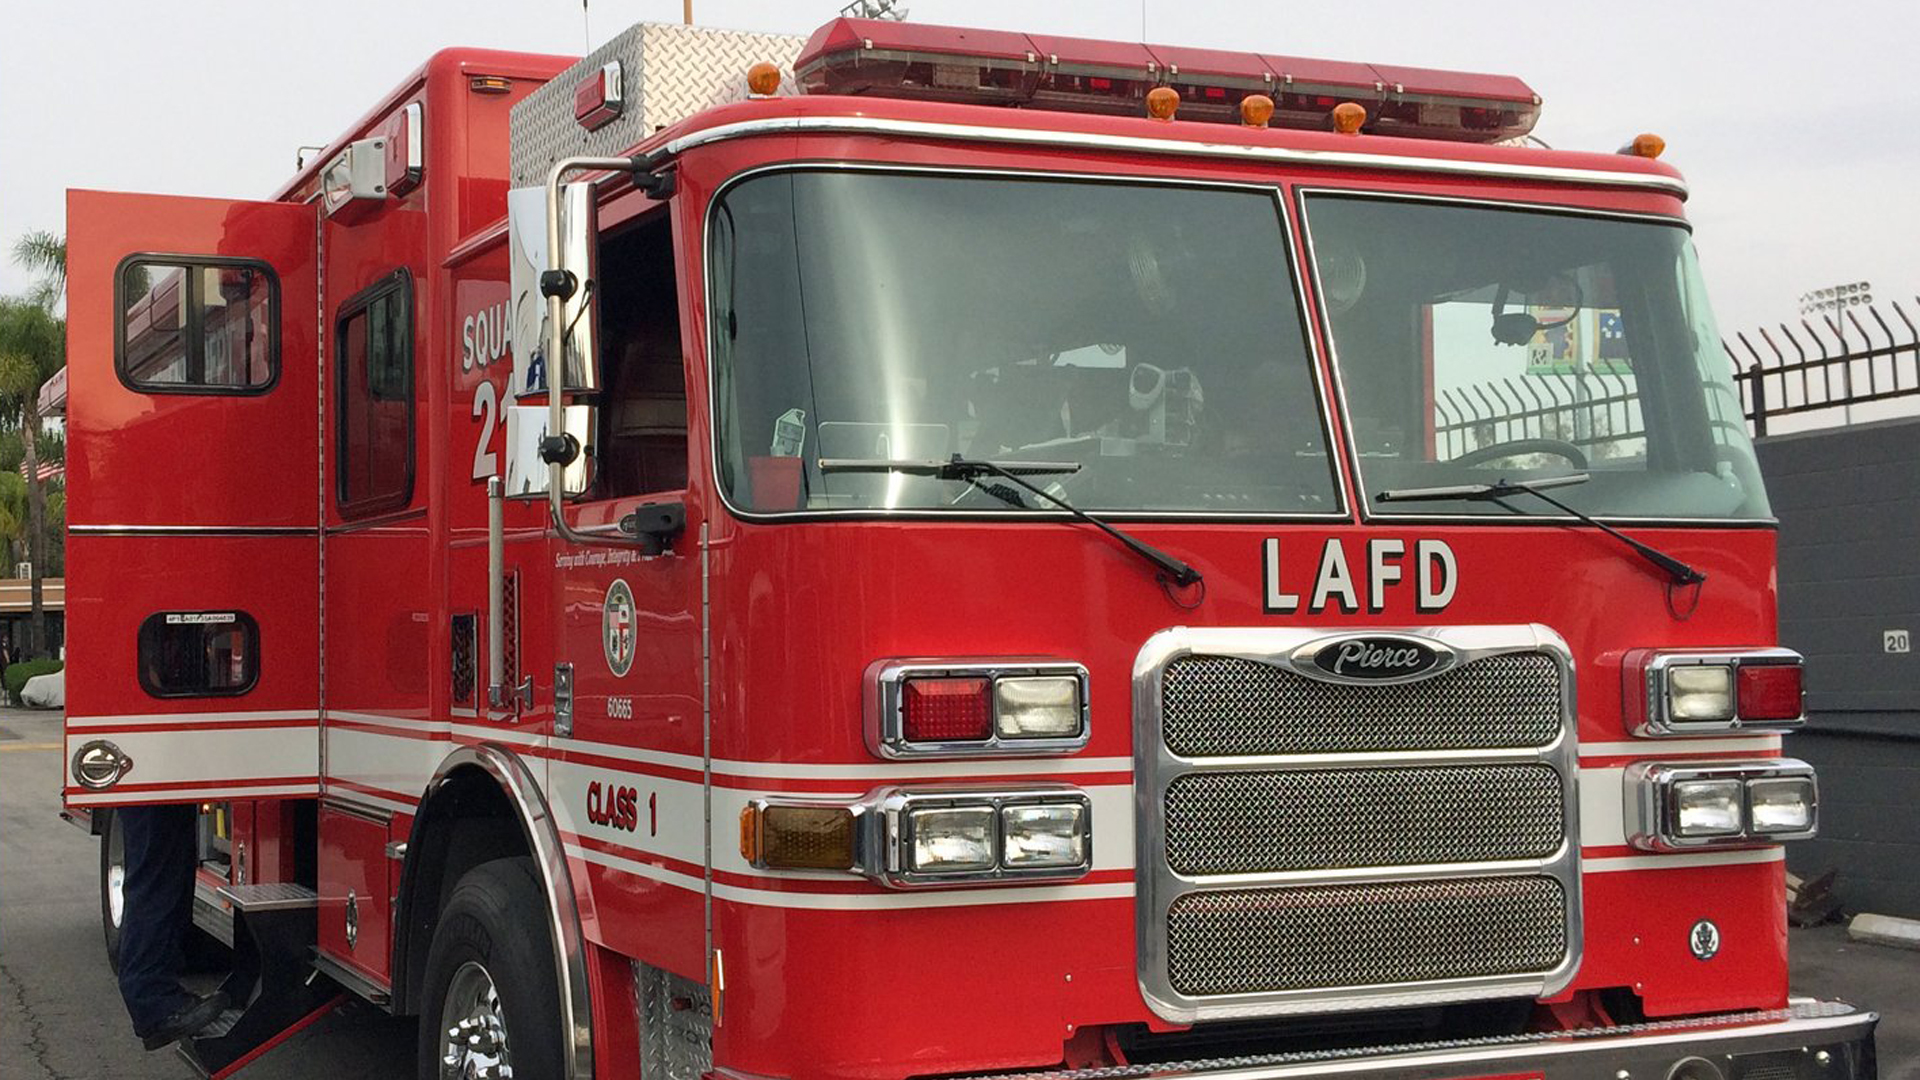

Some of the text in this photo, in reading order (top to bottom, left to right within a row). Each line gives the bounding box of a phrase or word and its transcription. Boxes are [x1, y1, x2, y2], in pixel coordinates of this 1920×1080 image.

[555, 551, 573, 570] Serving
[573, 550, 584, 566] with
[607, 547, 630, 567] Integrity
[1262, 537, 1459, 615] LAFD
[1333, 640, 1421, 674] Pierce
[1887, 635, 1907, 651] 20
[607, 696, 632, 719] 60665
[587, 780, 657, 837] CLASS 1
